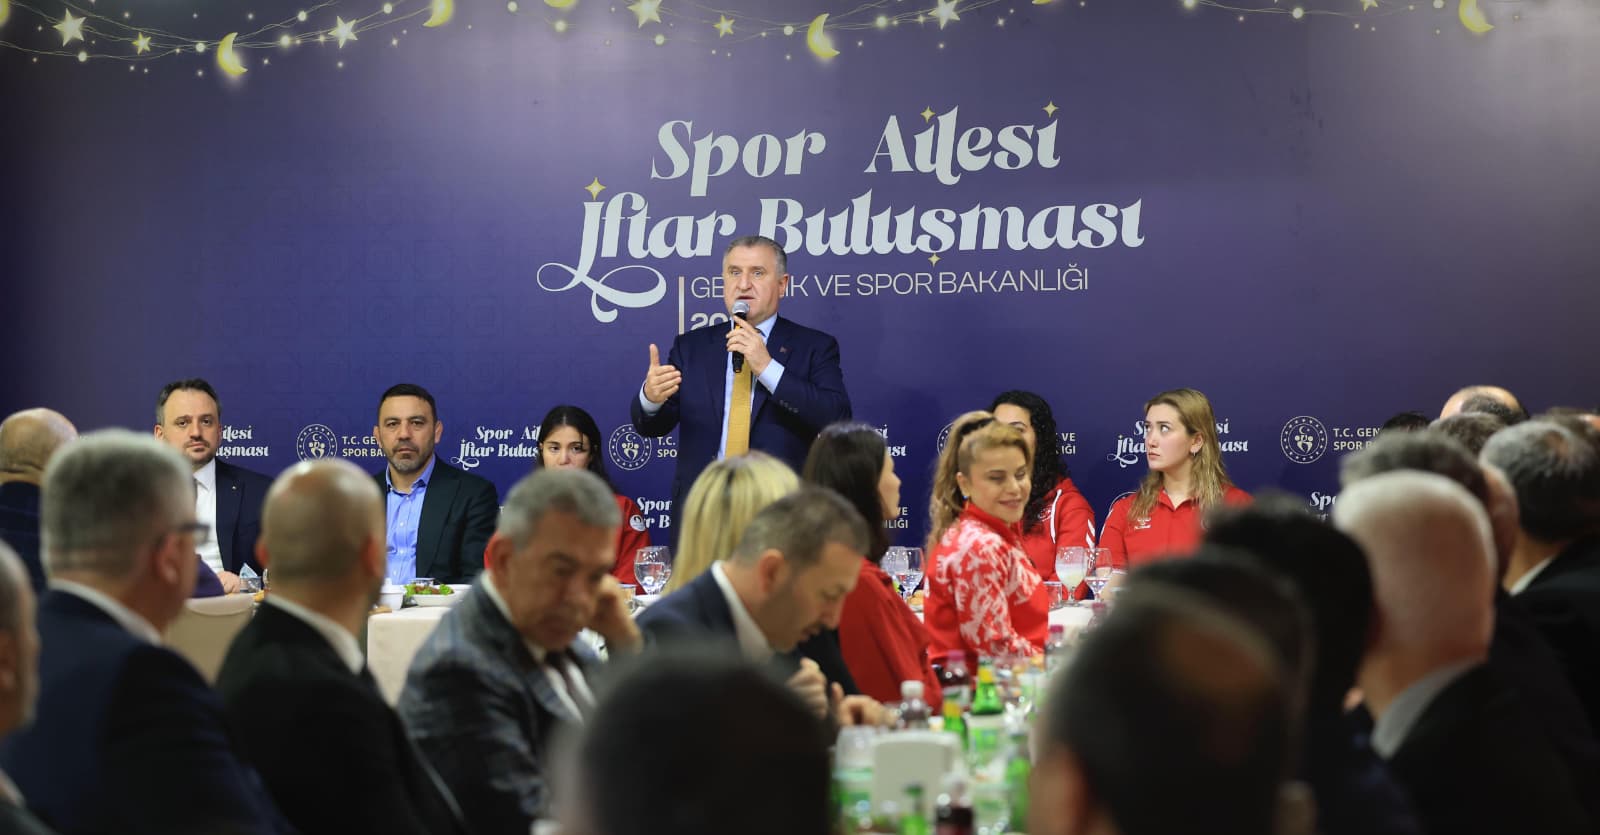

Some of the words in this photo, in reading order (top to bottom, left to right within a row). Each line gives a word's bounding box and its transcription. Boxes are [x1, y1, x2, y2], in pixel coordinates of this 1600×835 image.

[651, 119, 827, 197] Spor
[864, 100, 1061, 186] Ailesi
[758, 188, 1145, 268] Buluşması
[813, 274, 851, 297] VE
[856, 271, 933, 296] SPOR
[939, 263, 1089, 294] BAKANLIĞI
[475, 425, 514, 444] Spor
[1061, 432, 1076, 442] VE
[1332, 427, 1354, 438] T.C.
[342, 436, 361, 445] T.C.
[657, 436, 676, 446] T.C.
[1333, 441, 1363, 451] SPOR
[342, 448, 369, 457] SPOR
[657, 448, 678, 458] SPO
